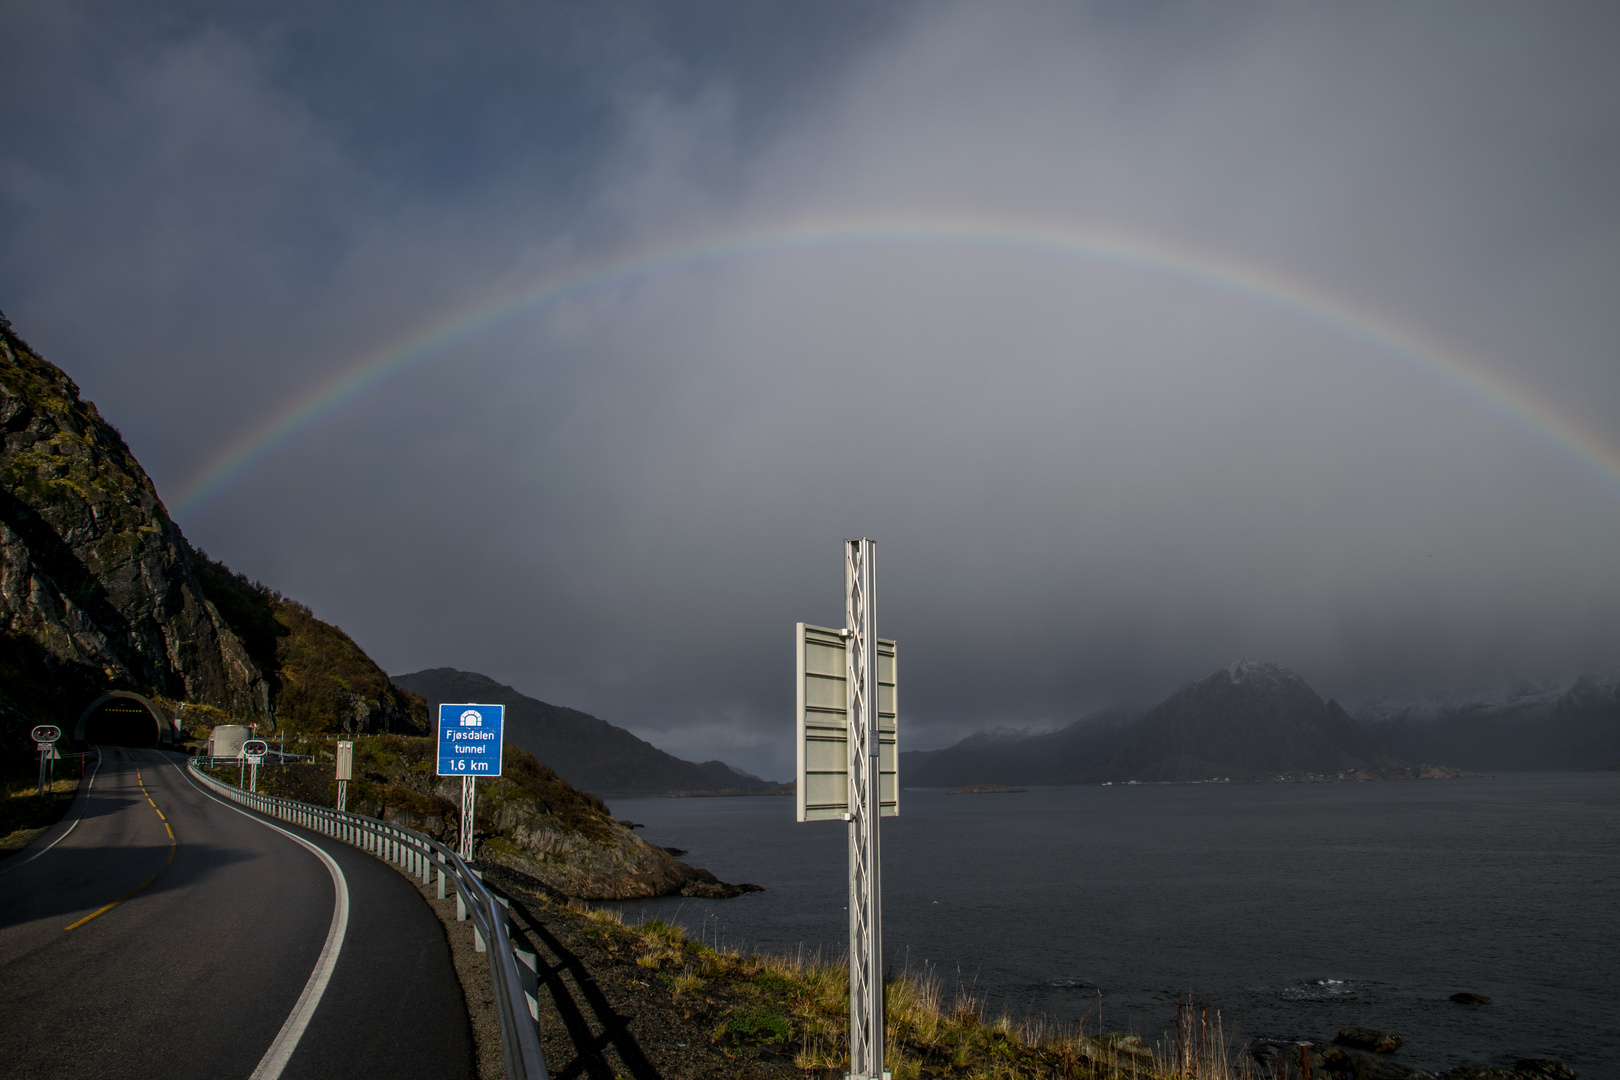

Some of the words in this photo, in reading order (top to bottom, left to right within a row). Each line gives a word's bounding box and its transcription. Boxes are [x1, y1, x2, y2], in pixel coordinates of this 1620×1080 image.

[446, 729, 494, 741] Fjøsdalen
[455, 744, 486, 754] tunnel
[450, 759, 466, 771] 1,6
[470, 760, 488, 771] km
